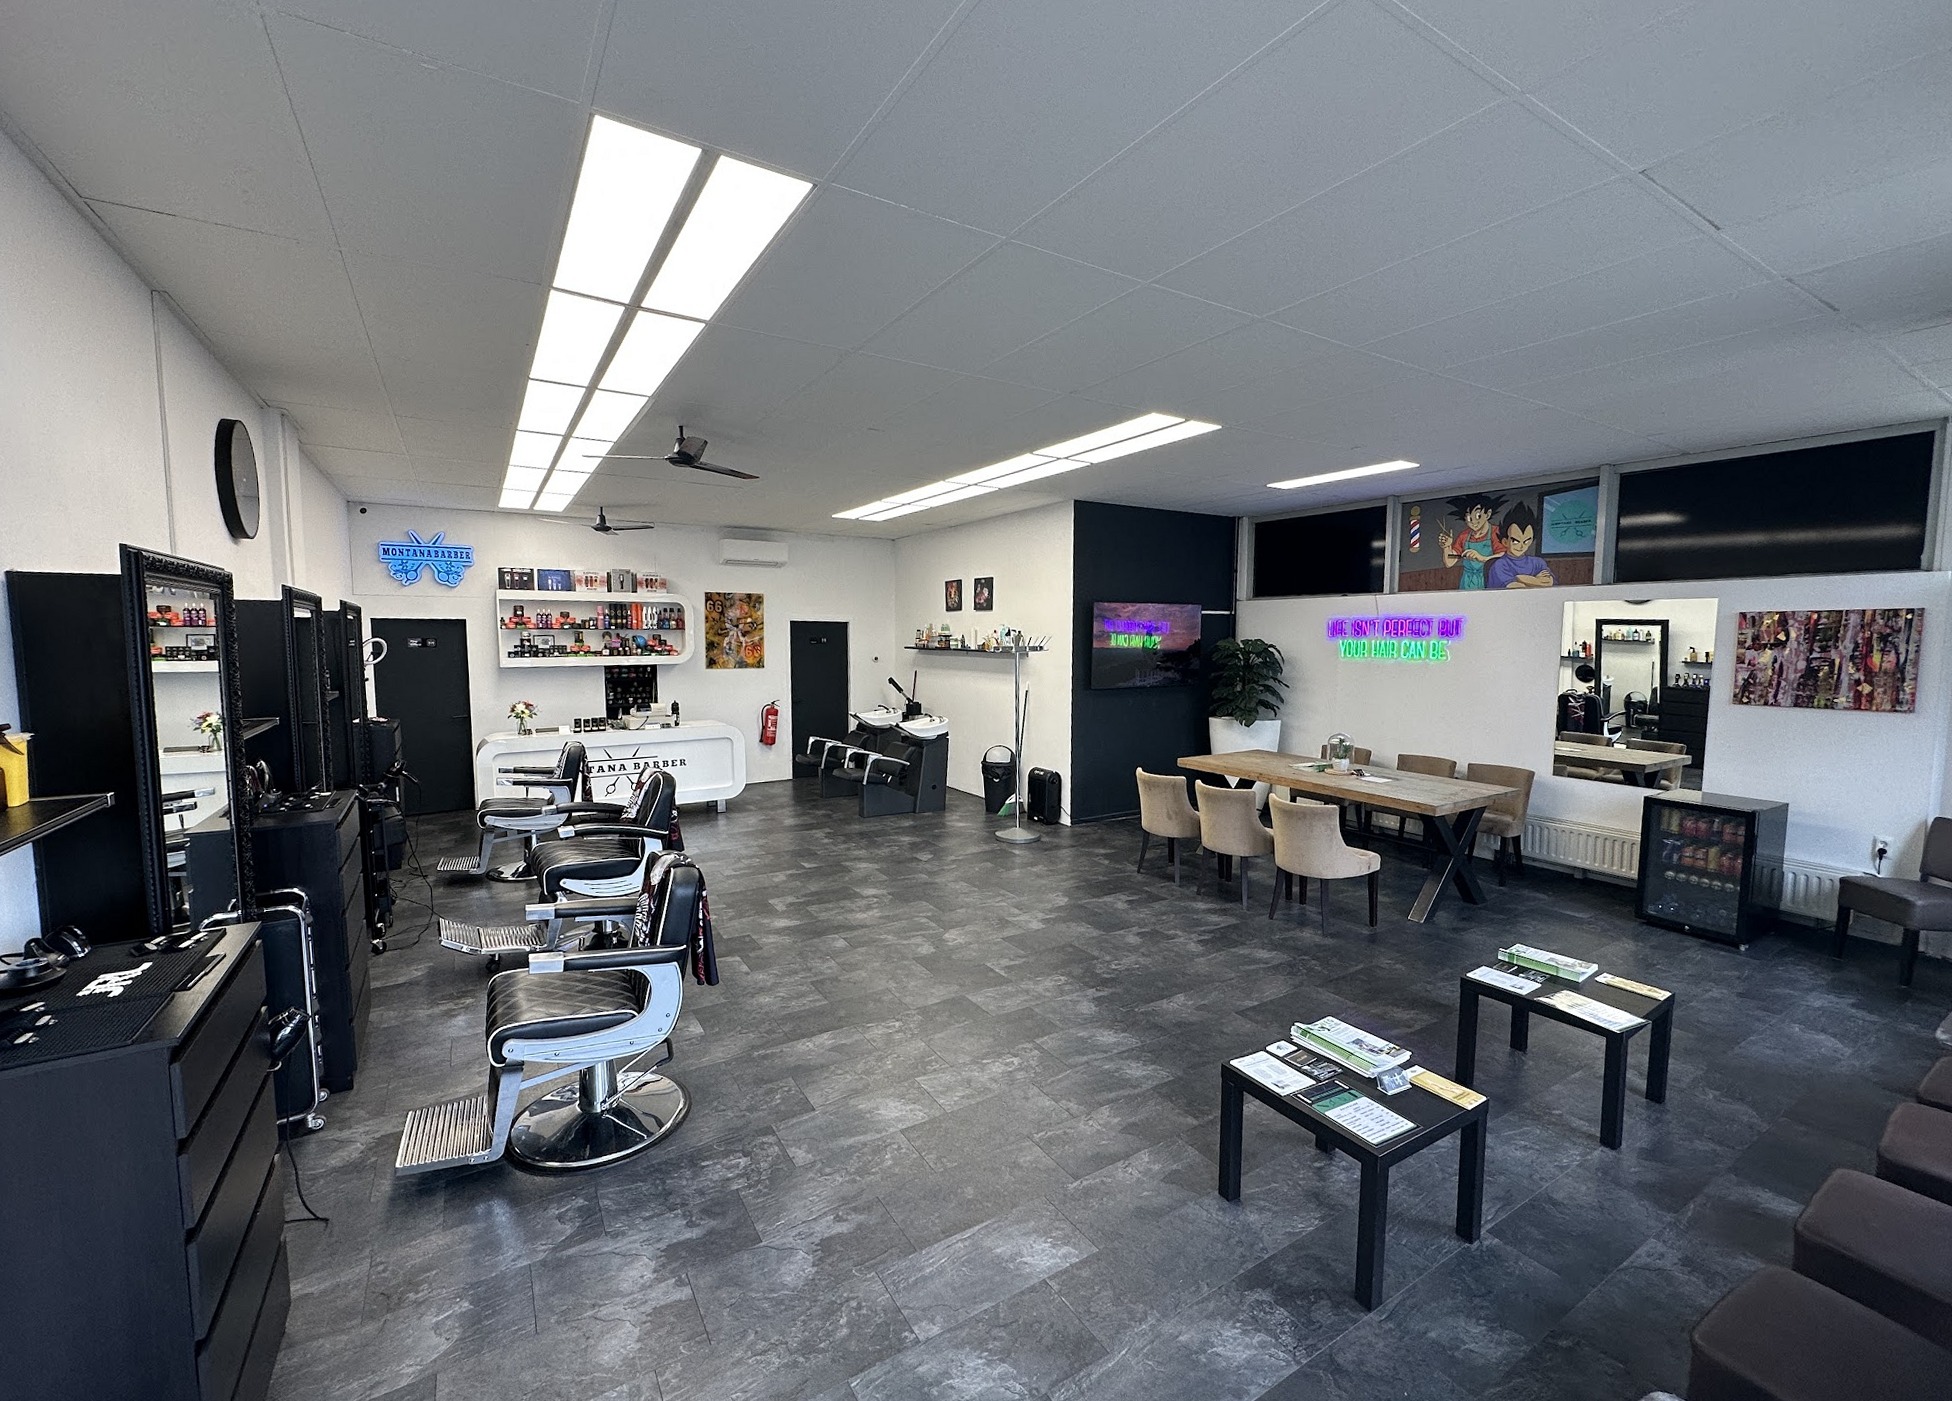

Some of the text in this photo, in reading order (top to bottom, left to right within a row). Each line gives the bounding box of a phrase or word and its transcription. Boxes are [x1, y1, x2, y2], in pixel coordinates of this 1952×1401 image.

[706, 600, 722, 613] 66
[1328, 618, 1464, 638] LIFE ISN'T PERFECT BUT
[1339, 640, 1448, 660] YOUR HAIR CAN BE
[588, 763, 627, 774] TANA
